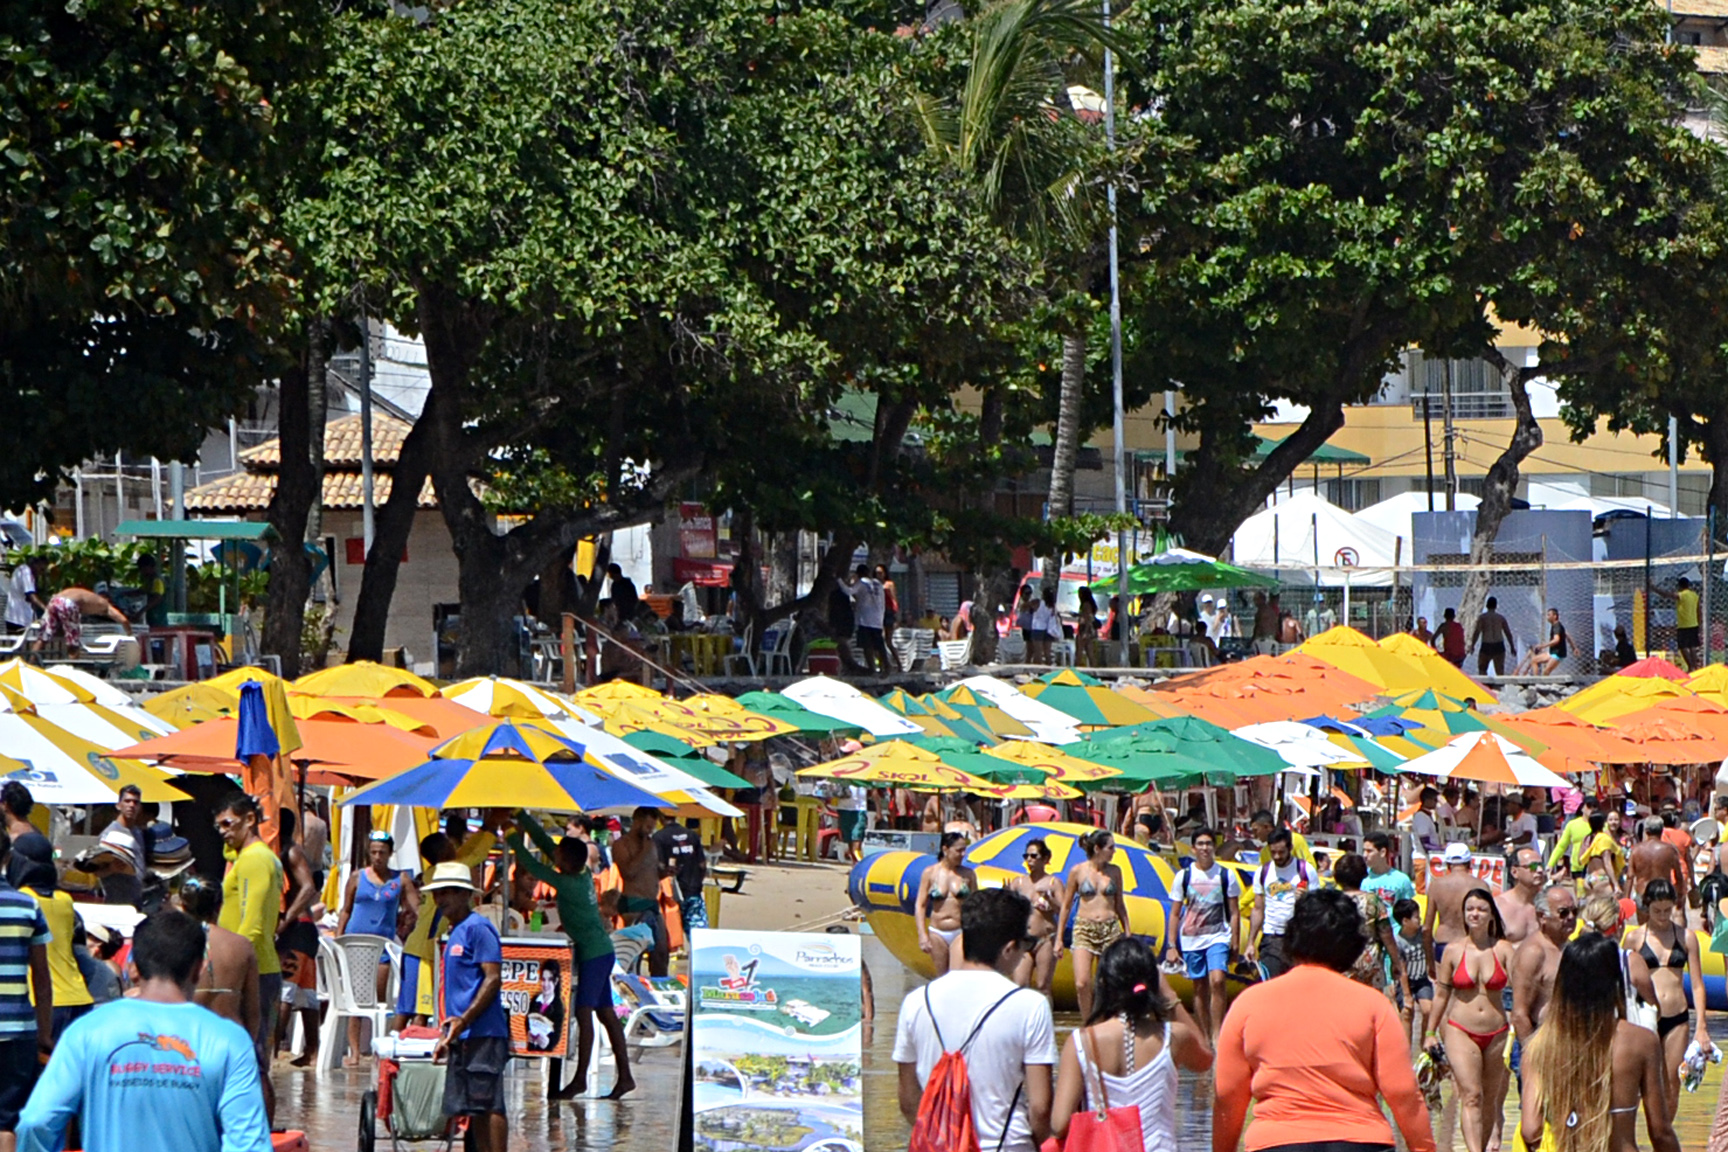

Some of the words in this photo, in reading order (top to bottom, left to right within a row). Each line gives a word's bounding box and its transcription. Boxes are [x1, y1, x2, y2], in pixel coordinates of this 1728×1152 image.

[877, 770, 932, 783] SKOL
[1430, 857, 1504, 885] CPE
[501, 961, 538, 982] EPE
[110, 1063, 150, 1075] BUGGY
[152, 1064, 201, 1077] SERVICE
